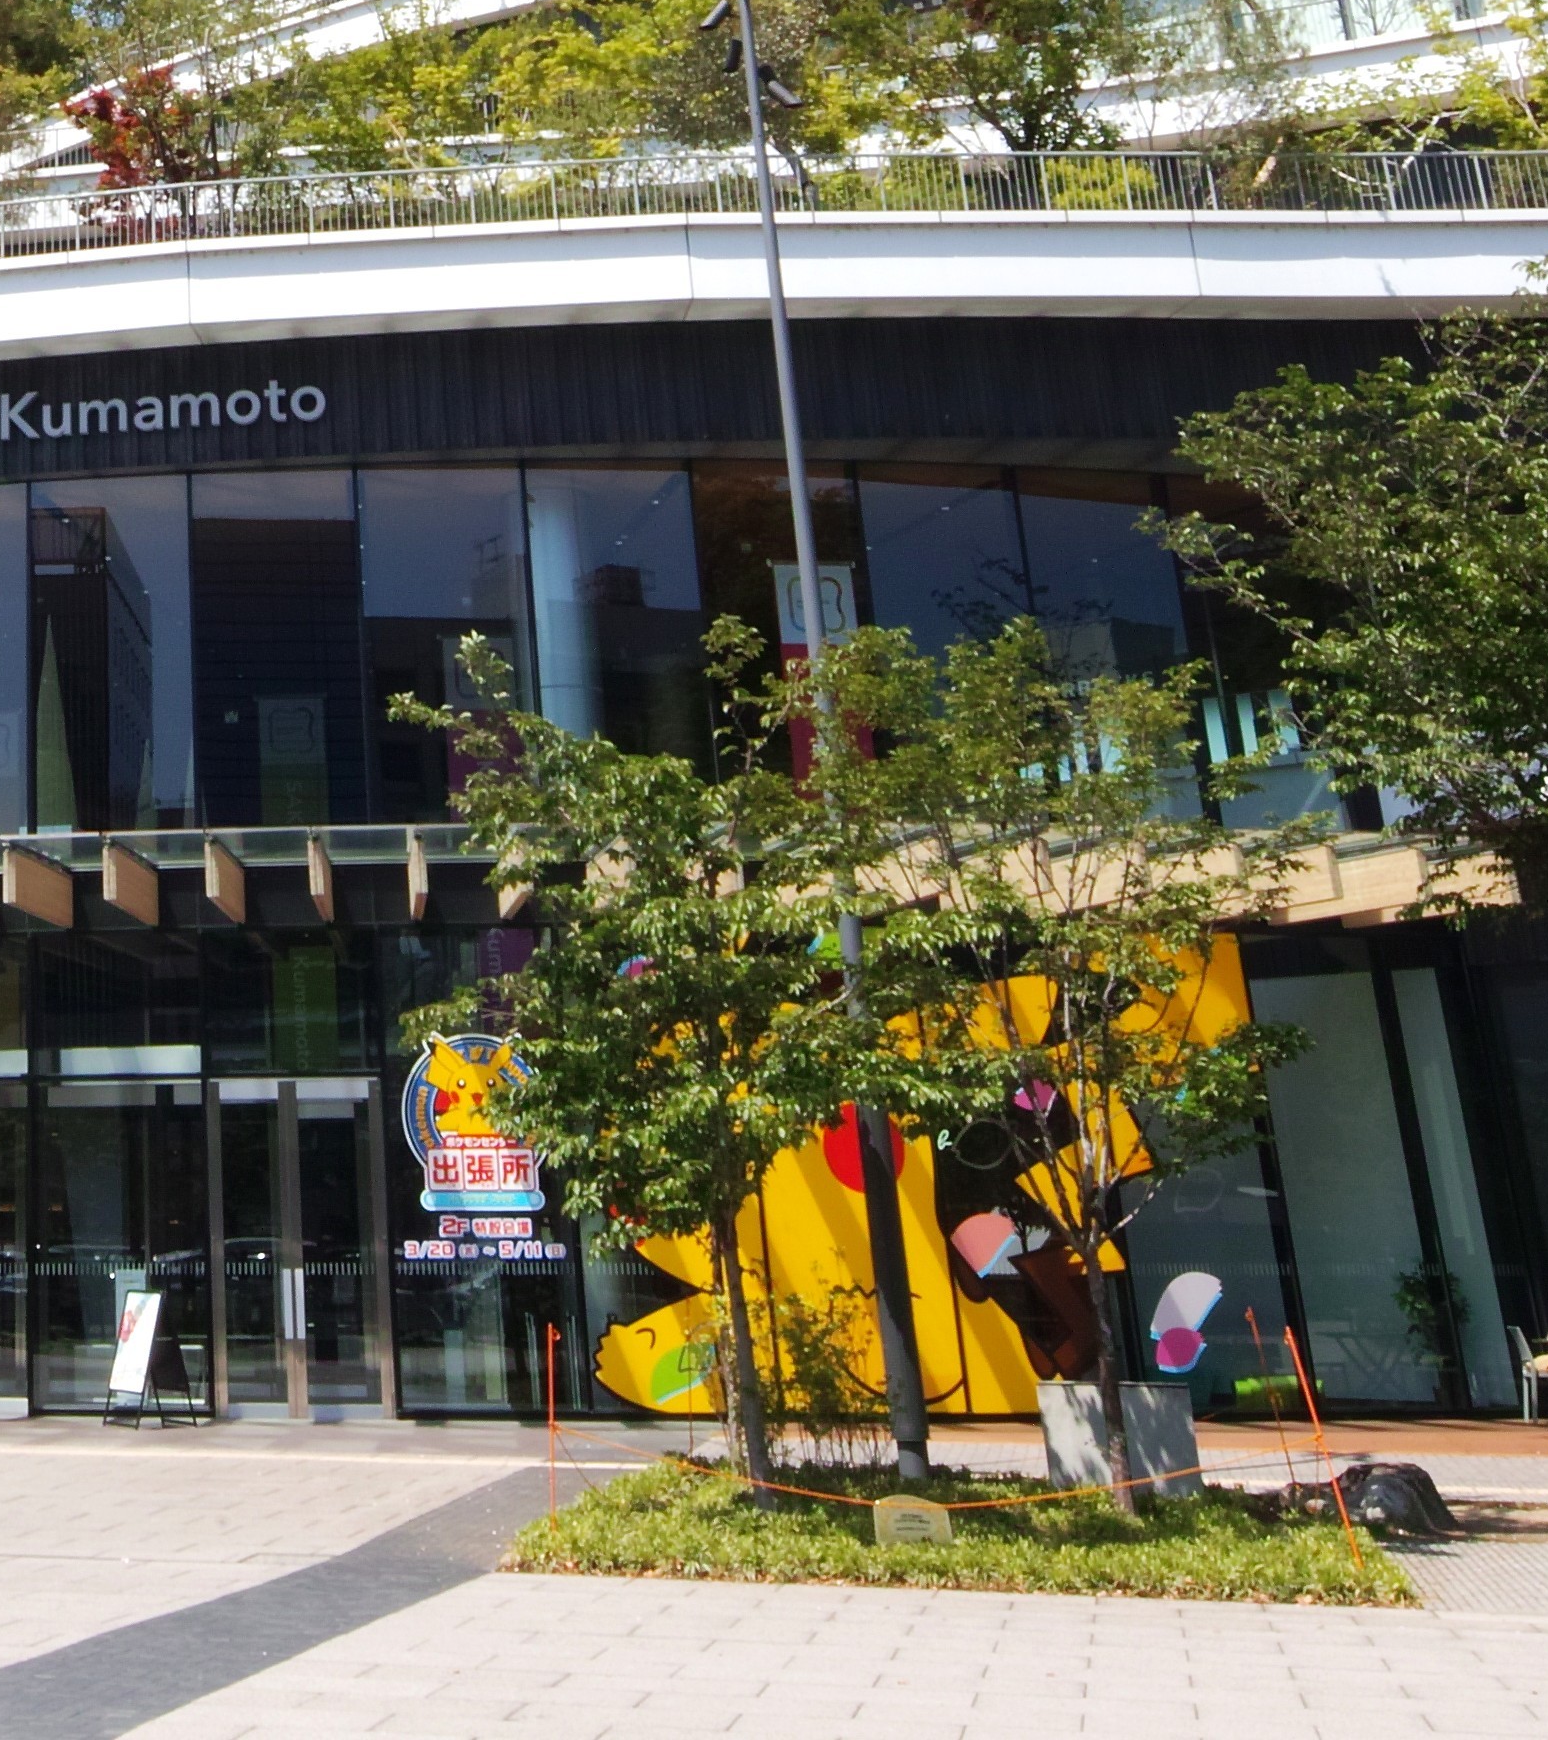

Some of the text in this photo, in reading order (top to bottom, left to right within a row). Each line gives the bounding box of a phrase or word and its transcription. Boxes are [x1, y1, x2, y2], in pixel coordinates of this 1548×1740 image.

[0, 379, 327, 441] Kumamoto
[445, 1136, 517, 1148] ポケモンセンター
[432, 1154, 530, 1185] 出張所
[440, 1216, 469, 1236] 2F
